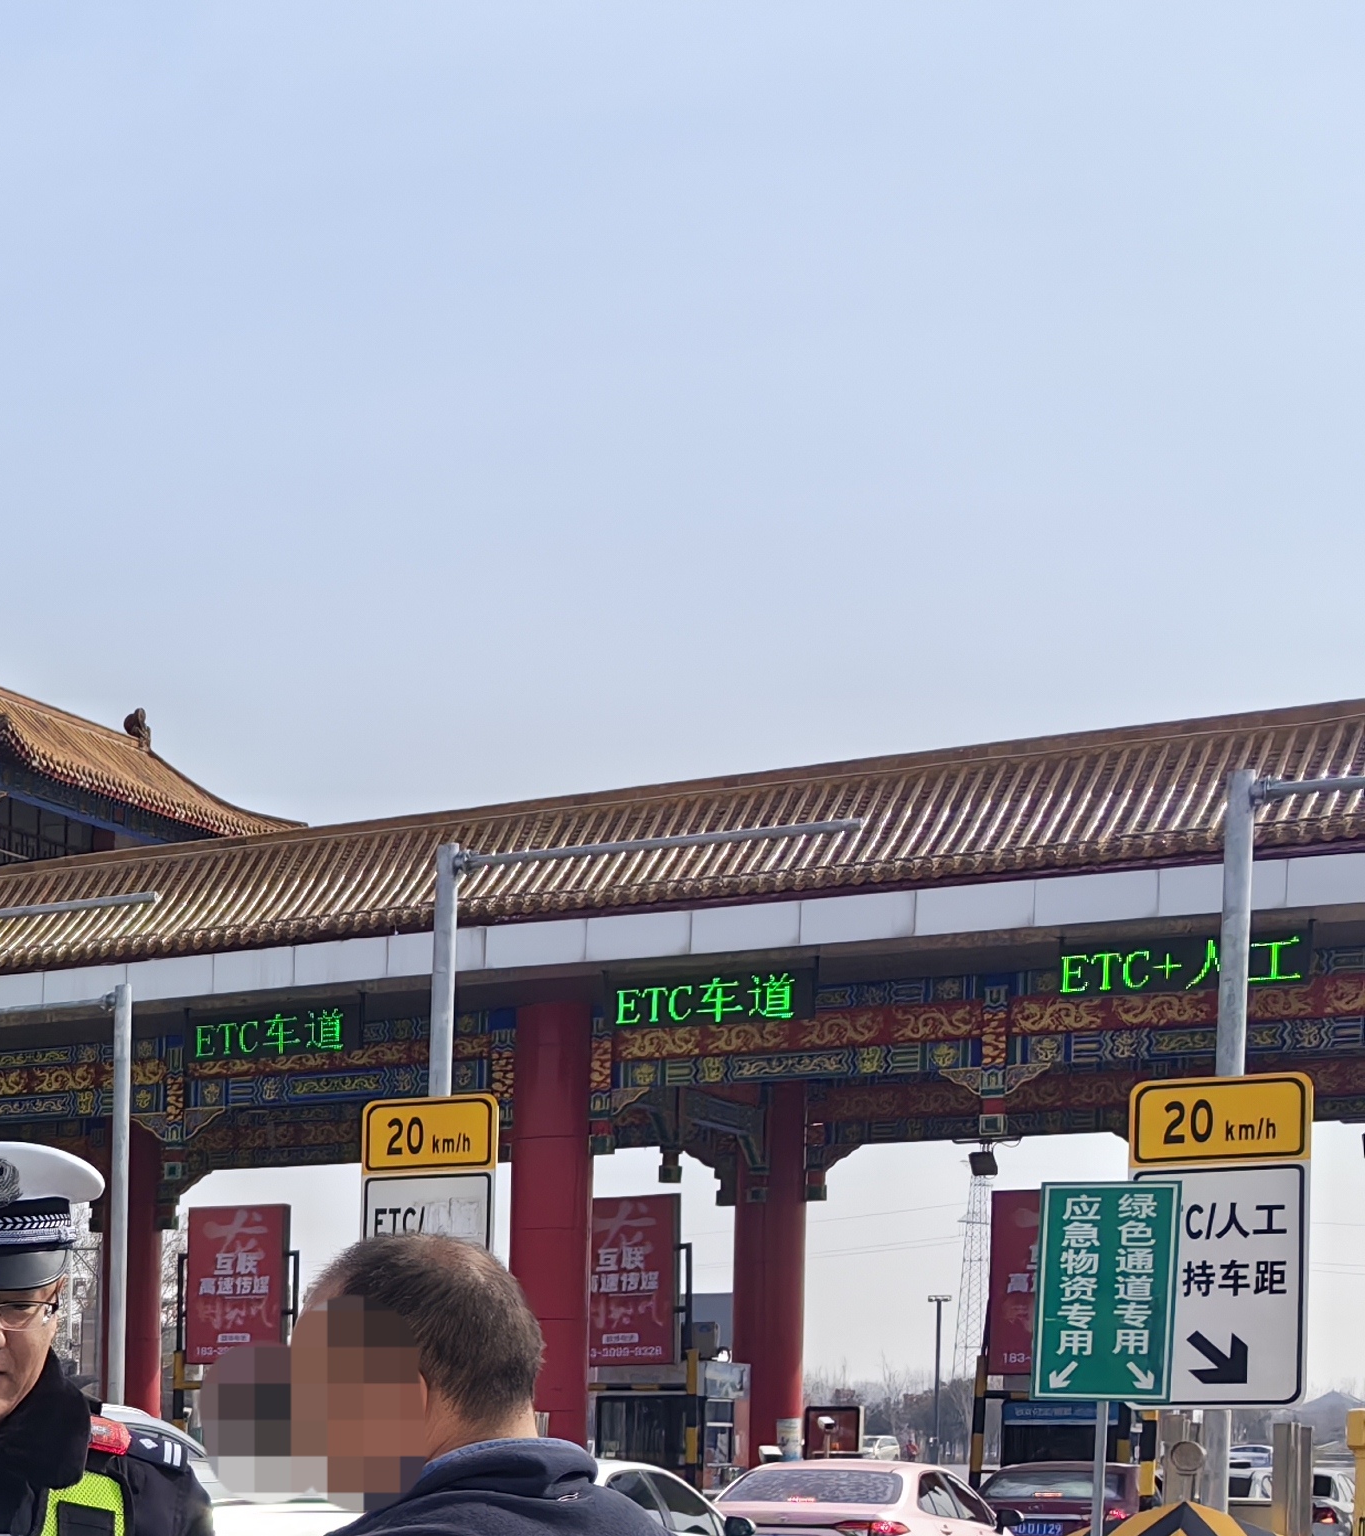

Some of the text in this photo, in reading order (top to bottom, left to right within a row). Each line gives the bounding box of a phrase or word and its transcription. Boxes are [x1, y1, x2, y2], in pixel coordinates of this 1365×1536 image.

[616, 973, 795, 1024] ETC车道
[196, 1008, 343, 1057] ETC车道
[386, 1116, 471, 1156] 20 km/h
[1163, 1099, 1276, 1144] 20 km/h
[1181, 1202, 1287, 1240] C/人工
[199, 1276, 270, 1296] 高速传媒
[1056, 1194, 1102, 1356] 应急物资专用
[1112, 1193, 1158, 1355] 绿色通道专用
[1182, 1259, 1287, 1297] 持车距
